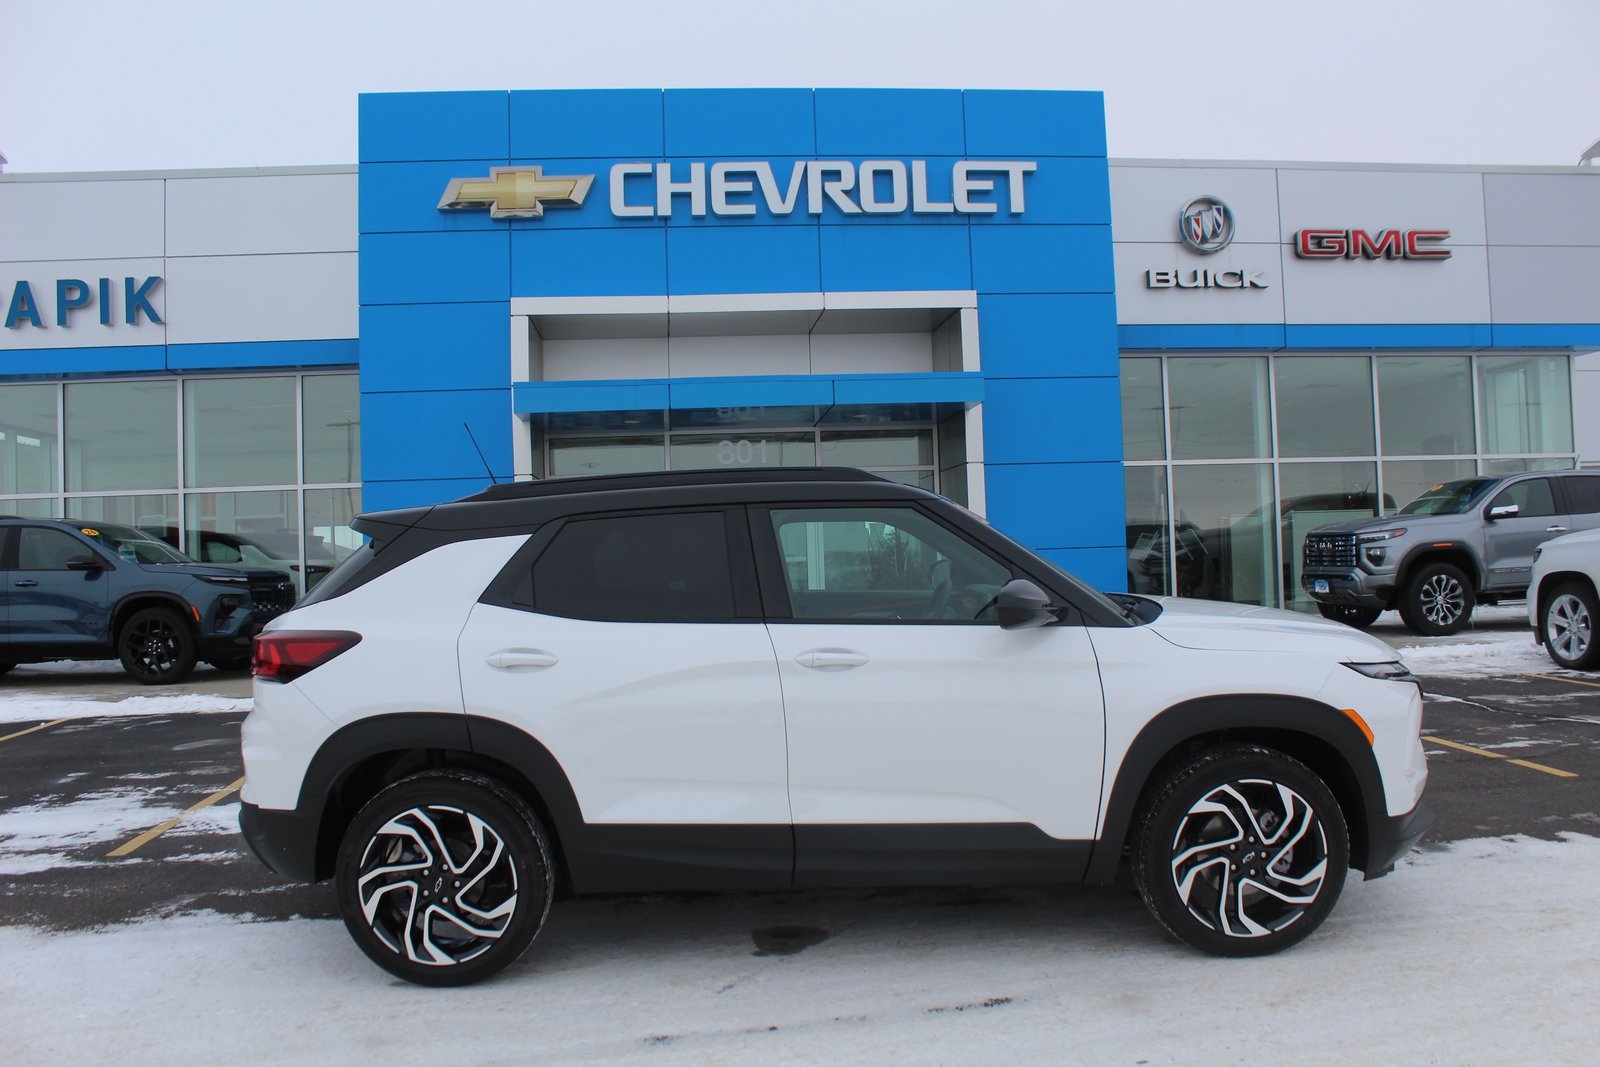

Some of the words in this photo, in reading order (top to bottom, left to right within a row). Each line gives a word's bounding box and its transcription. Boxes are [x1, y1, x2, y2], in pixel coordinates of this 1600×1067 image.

[609, 160, 1038, 217] CHEVROLET
[1295, 229, 1451, 259] GMC
[1146, 269, 1268, 288] BUICK
[0, 276, 166, 328] APIK
[718, 439, 767, 464] 801
